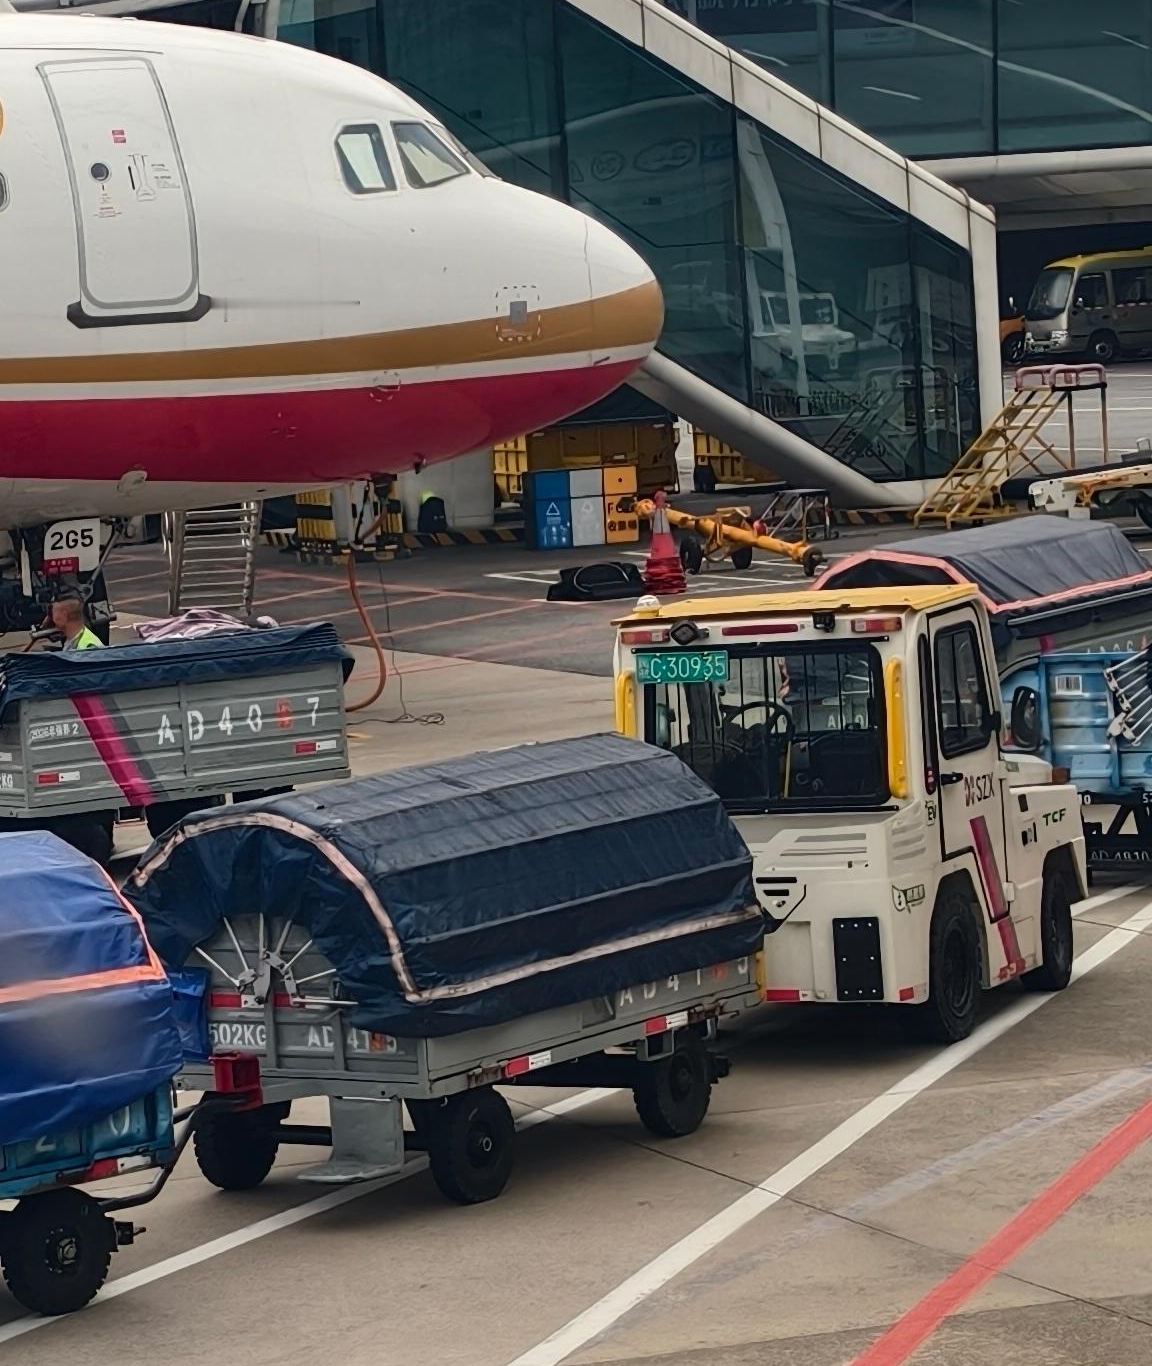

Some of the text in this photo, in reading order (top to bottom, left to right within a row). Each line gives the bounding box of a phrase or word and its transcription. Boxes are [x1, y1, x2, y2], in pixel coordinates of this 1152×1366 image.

[50, 527, 94, 551] 2G5
[975, 771, 995, 802] SZX
[1042, 807, 1066, 827] TCF
[209, 1022, 266, 1047] 502KG
